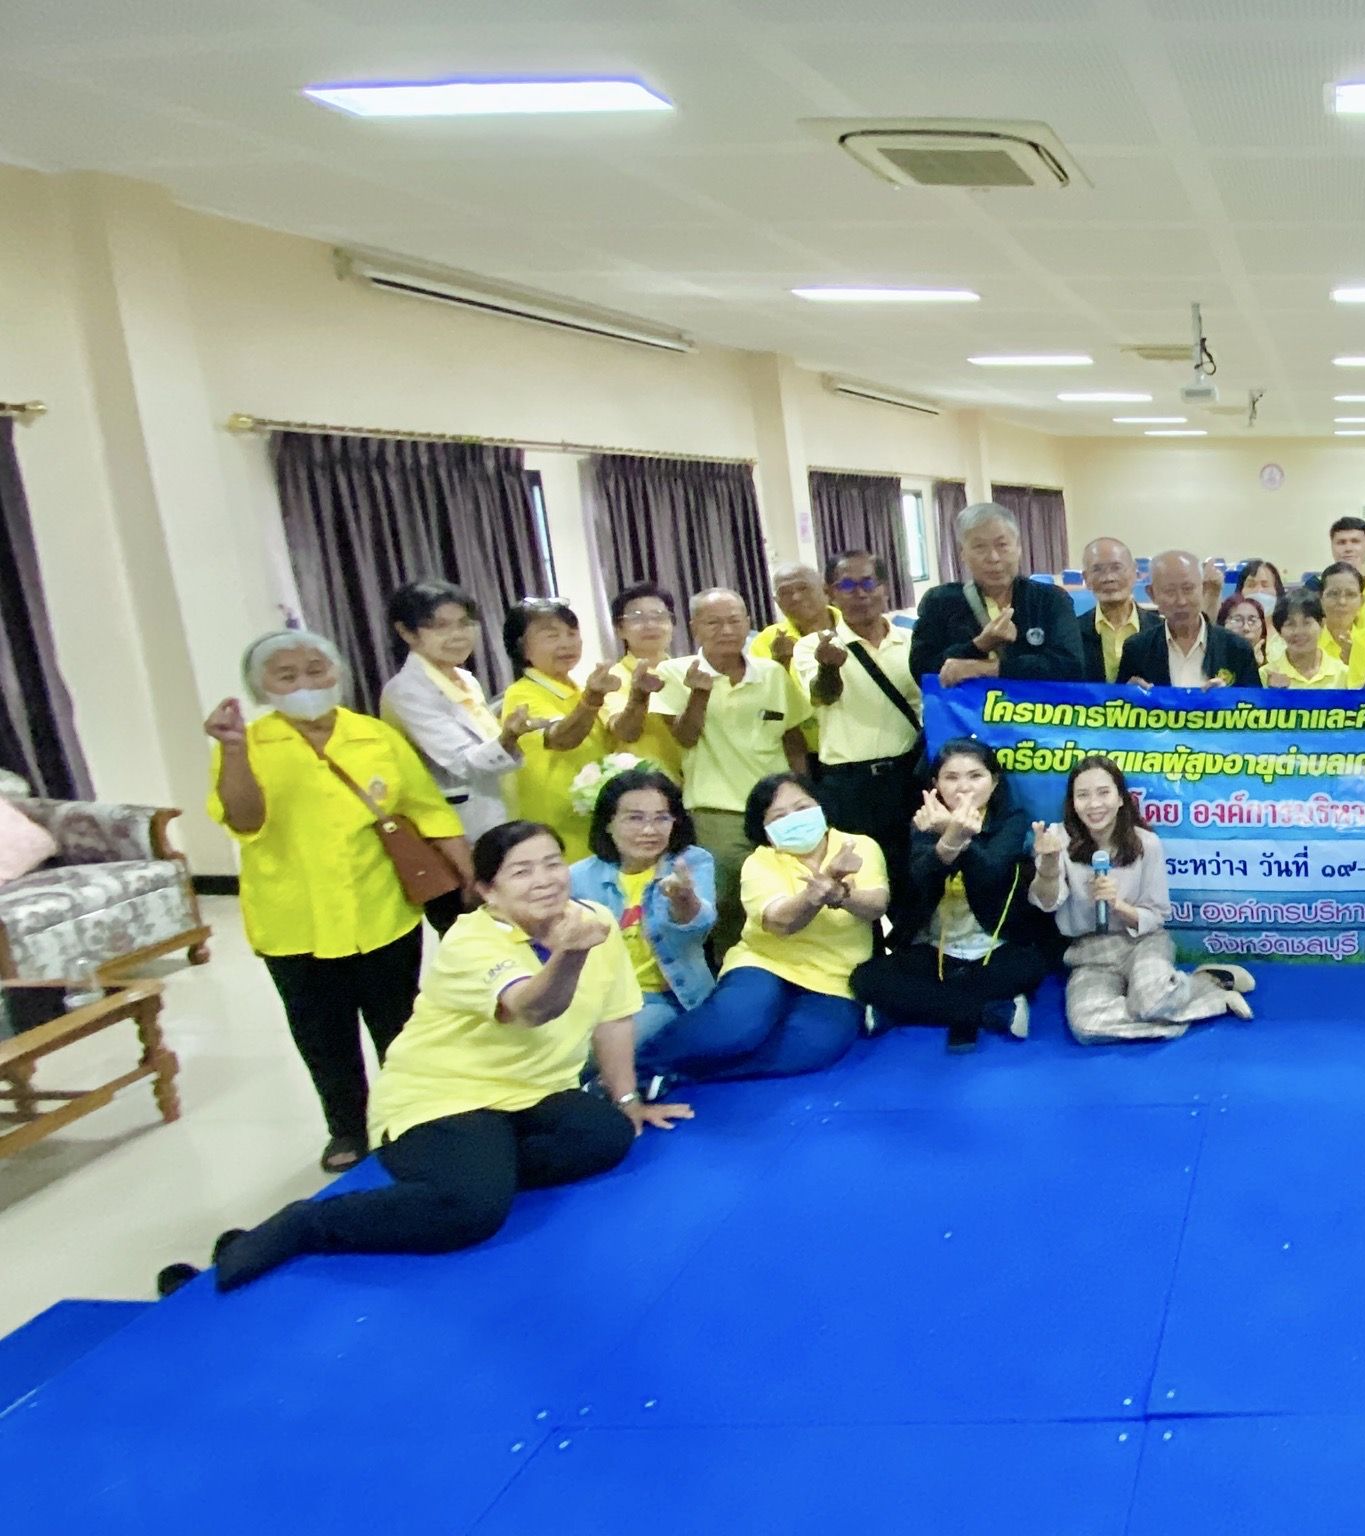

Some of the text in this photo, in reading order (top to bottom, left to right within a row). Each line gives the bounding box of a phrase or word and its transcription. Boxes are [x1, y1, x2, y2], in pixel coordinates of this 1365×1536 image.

[1259, 846, 1310, 878] วันที่
[1205, 931, 1359, 959] จังหวัดชลบุรี
